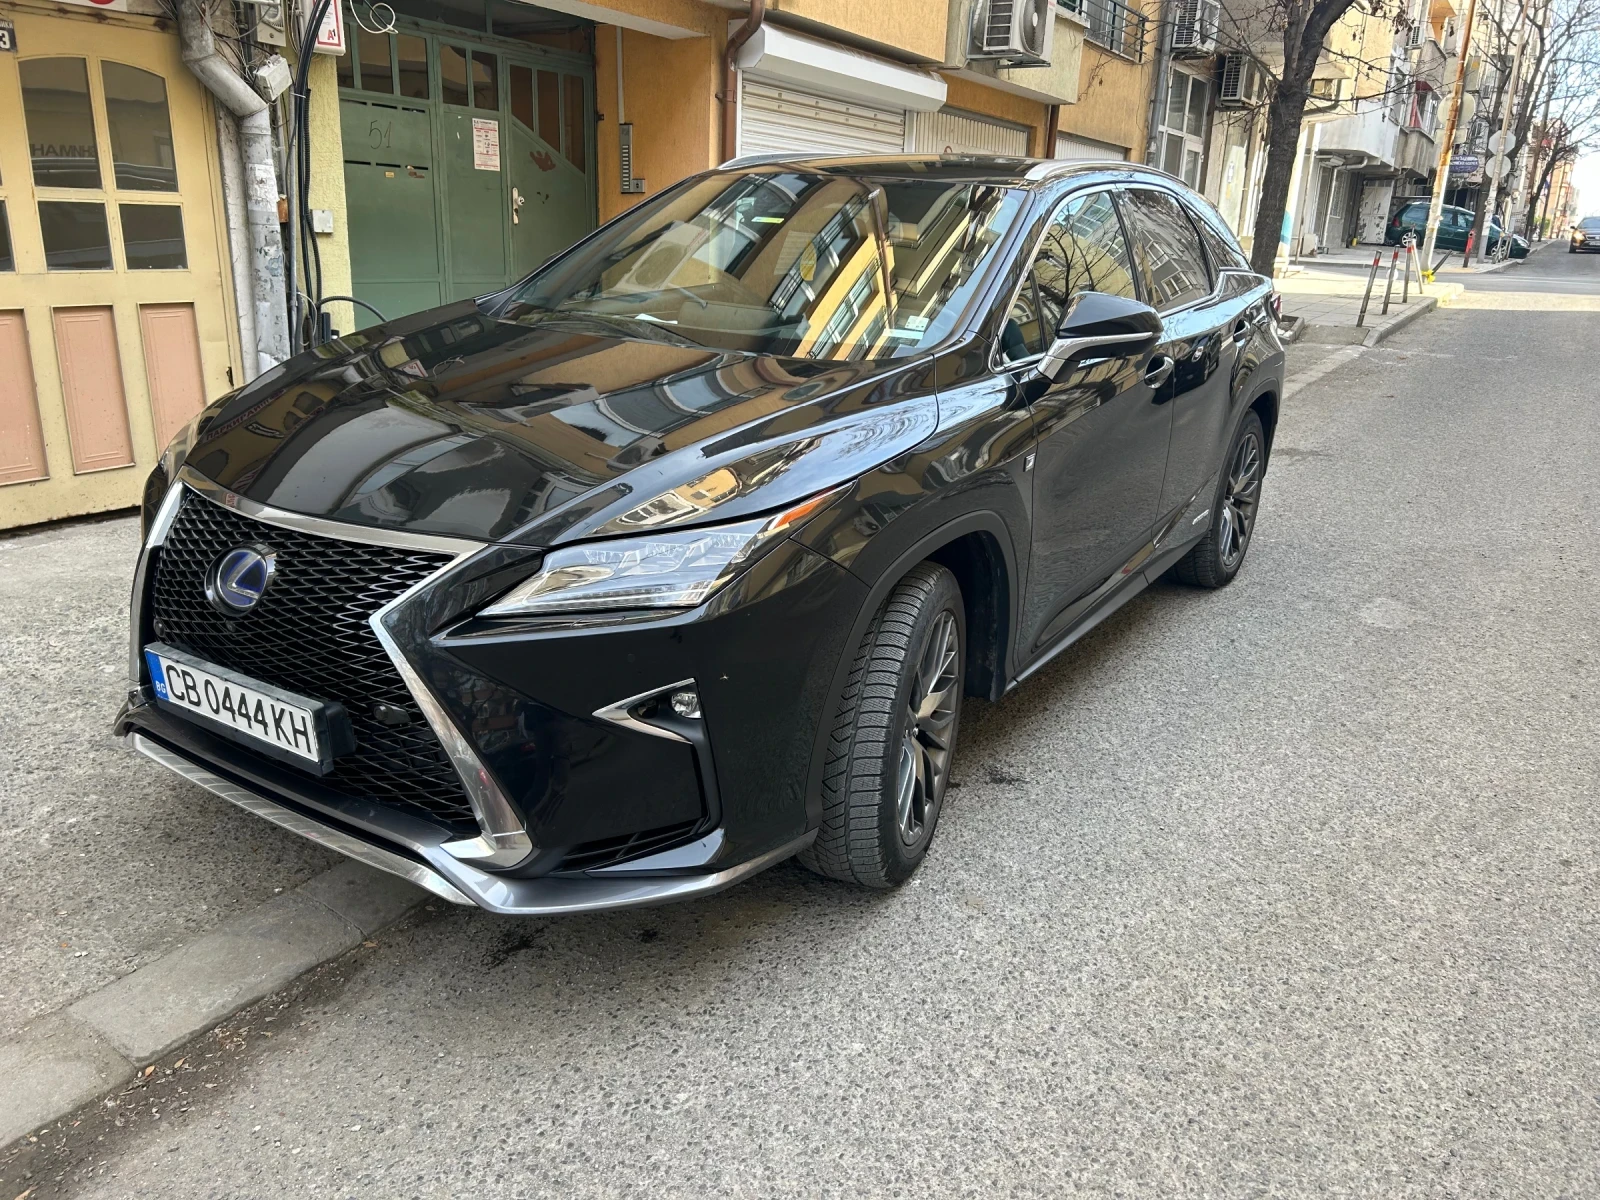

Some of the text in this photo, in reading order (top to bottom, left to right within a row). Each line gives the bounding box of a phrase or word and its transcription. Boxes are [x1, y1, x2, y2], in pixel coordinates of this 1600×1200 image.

[327, 28, 336, 40] A1
[369, 119, 391, 149] 51
[155, 680, 166, 694] BG
[204, 678, 269, 737] 0444
